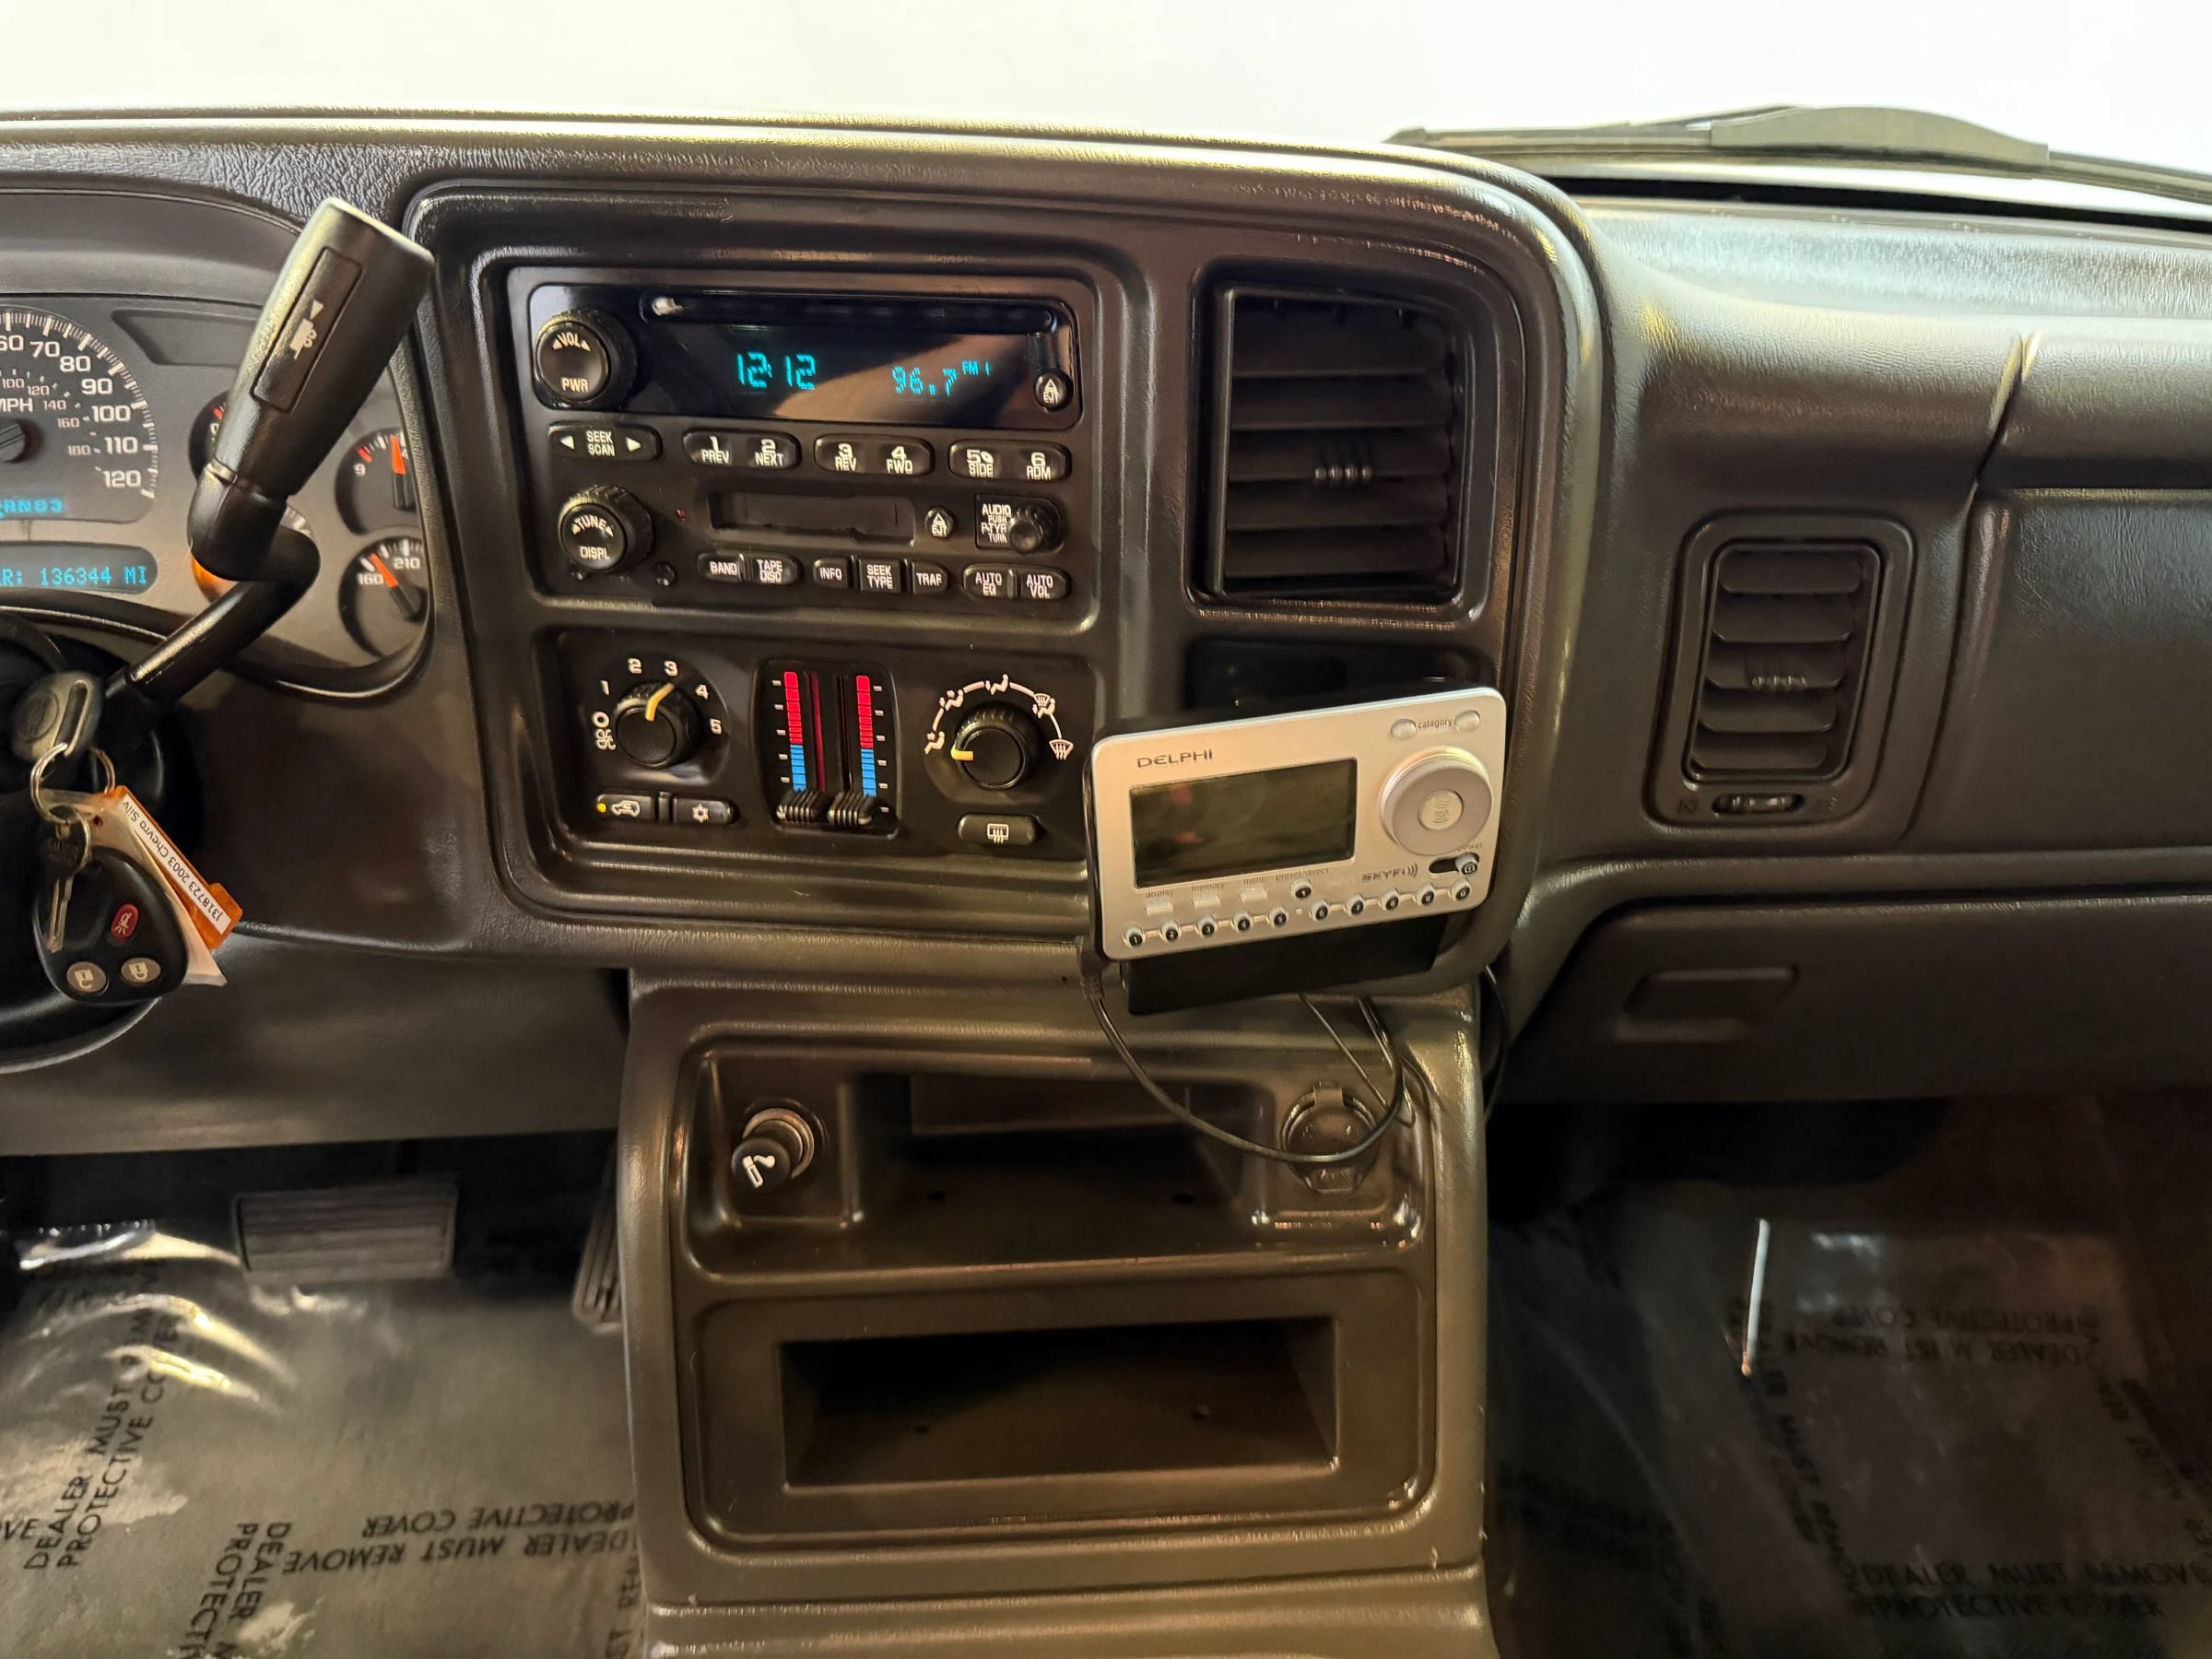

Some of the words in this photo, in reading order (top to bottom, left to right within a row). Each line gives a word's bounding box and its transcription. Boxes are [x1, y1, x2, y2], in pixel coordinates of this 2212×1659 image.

[559, 332, 581, 347] VOL
[29, 341, 60, 358] 70
[60, 356, 91, 372] 80
[2, 378, 25, 389] 100
[81, 378, 112, 394] 90
[561, 377, 589, 394] PWR
[892, 366, 957, 396] 96.7
[28, 385, 50, 396] 120
[43, 399, 67, 410] 140
[91, 405, 131, 422] 100
[57, 418, 79, 428] 160
[586, 430, 612, 443] SEEK
[709, 436, 719, 452] 1
[104, 437, 138, 454] 110
[588, 442, 615, 456] SCAN
[761, 439, 776, 453] 2
[838, 443, 853, 458] 3
[891, 446, 907, 460] 4
[700, 449, 730, 465] PREV
[755, 452, 783, 466] NEXT
[835, 456, 857, 472] REV
[1031, 452, 1045, 466] 6
[354, 464, 366, 477] 9
[886, 459, 913, 475] FWD
[968, 463, 994, 477] SIDE
[1027, 465, 1051, 480] RDM
[103, 470, 141, 488] 120
[982, 503, 1012, 518] AUDIO
[575, 515, 607, 529] TUNE
[988, 514, 1007, 525] PUSH
[988, 533, 1007, 544] TURN
[580, 546, 611, 561] DISPL
[394, 558, 420, 570] 210
[709, 561, 737, 576] BAND
[757, 559, 782, 572] TAPE
[866, 564, 891, 577] SEEK
[0, 568, 23, 587] R:
[40, 566, 112, 587] 136344
[124, 566, 147, 584] MI
[759, 571, 782, 583] DISC
[819, 567, 842, 581] INFO
[916, 572, 942, 587] TRAF
[975, 572, 1002, 586] AUTO
[1026, 574, 1053, 589] AUTO
[867, 575, 893, 590] TYPE
[982, 583, 997, 596] EQ
[1030, 585, 1051, 599] VOL
[628, 657, 642, 675] 2
[664, 660, 678, 677] 3
[600, 679, 610, 696] 1
[695, 684, 709, 700] 4
[710, 718, 723, 735] 5
[1418, 718, 1453, 728] category
[1137, 749, 1213, 768] DELPHI
[124, 801, 140, 822] Silv
[140, 820, 169, 858] Chevro
[168, 856, 190, 884] 2003
[189, 881, 222, 922] J318723
[1146, 889, 1175, 900] display
[24, 1475, 92, 1570] DEALER
[88, 1384, 134, 1455] MUST
[56, 1416, 153, 1568] PROTECTIVE
[468, 1500, 634, 1529] PROTECTIVE
[362, 1509, 455, 1538] COVER
[421, 1535, 505, 1560] MUST
[524, 1530, 629, 1557] DEALER
[282, 1542, 406, 1574] REMOVE
[229, 1523, 292, 1619] DEALER
